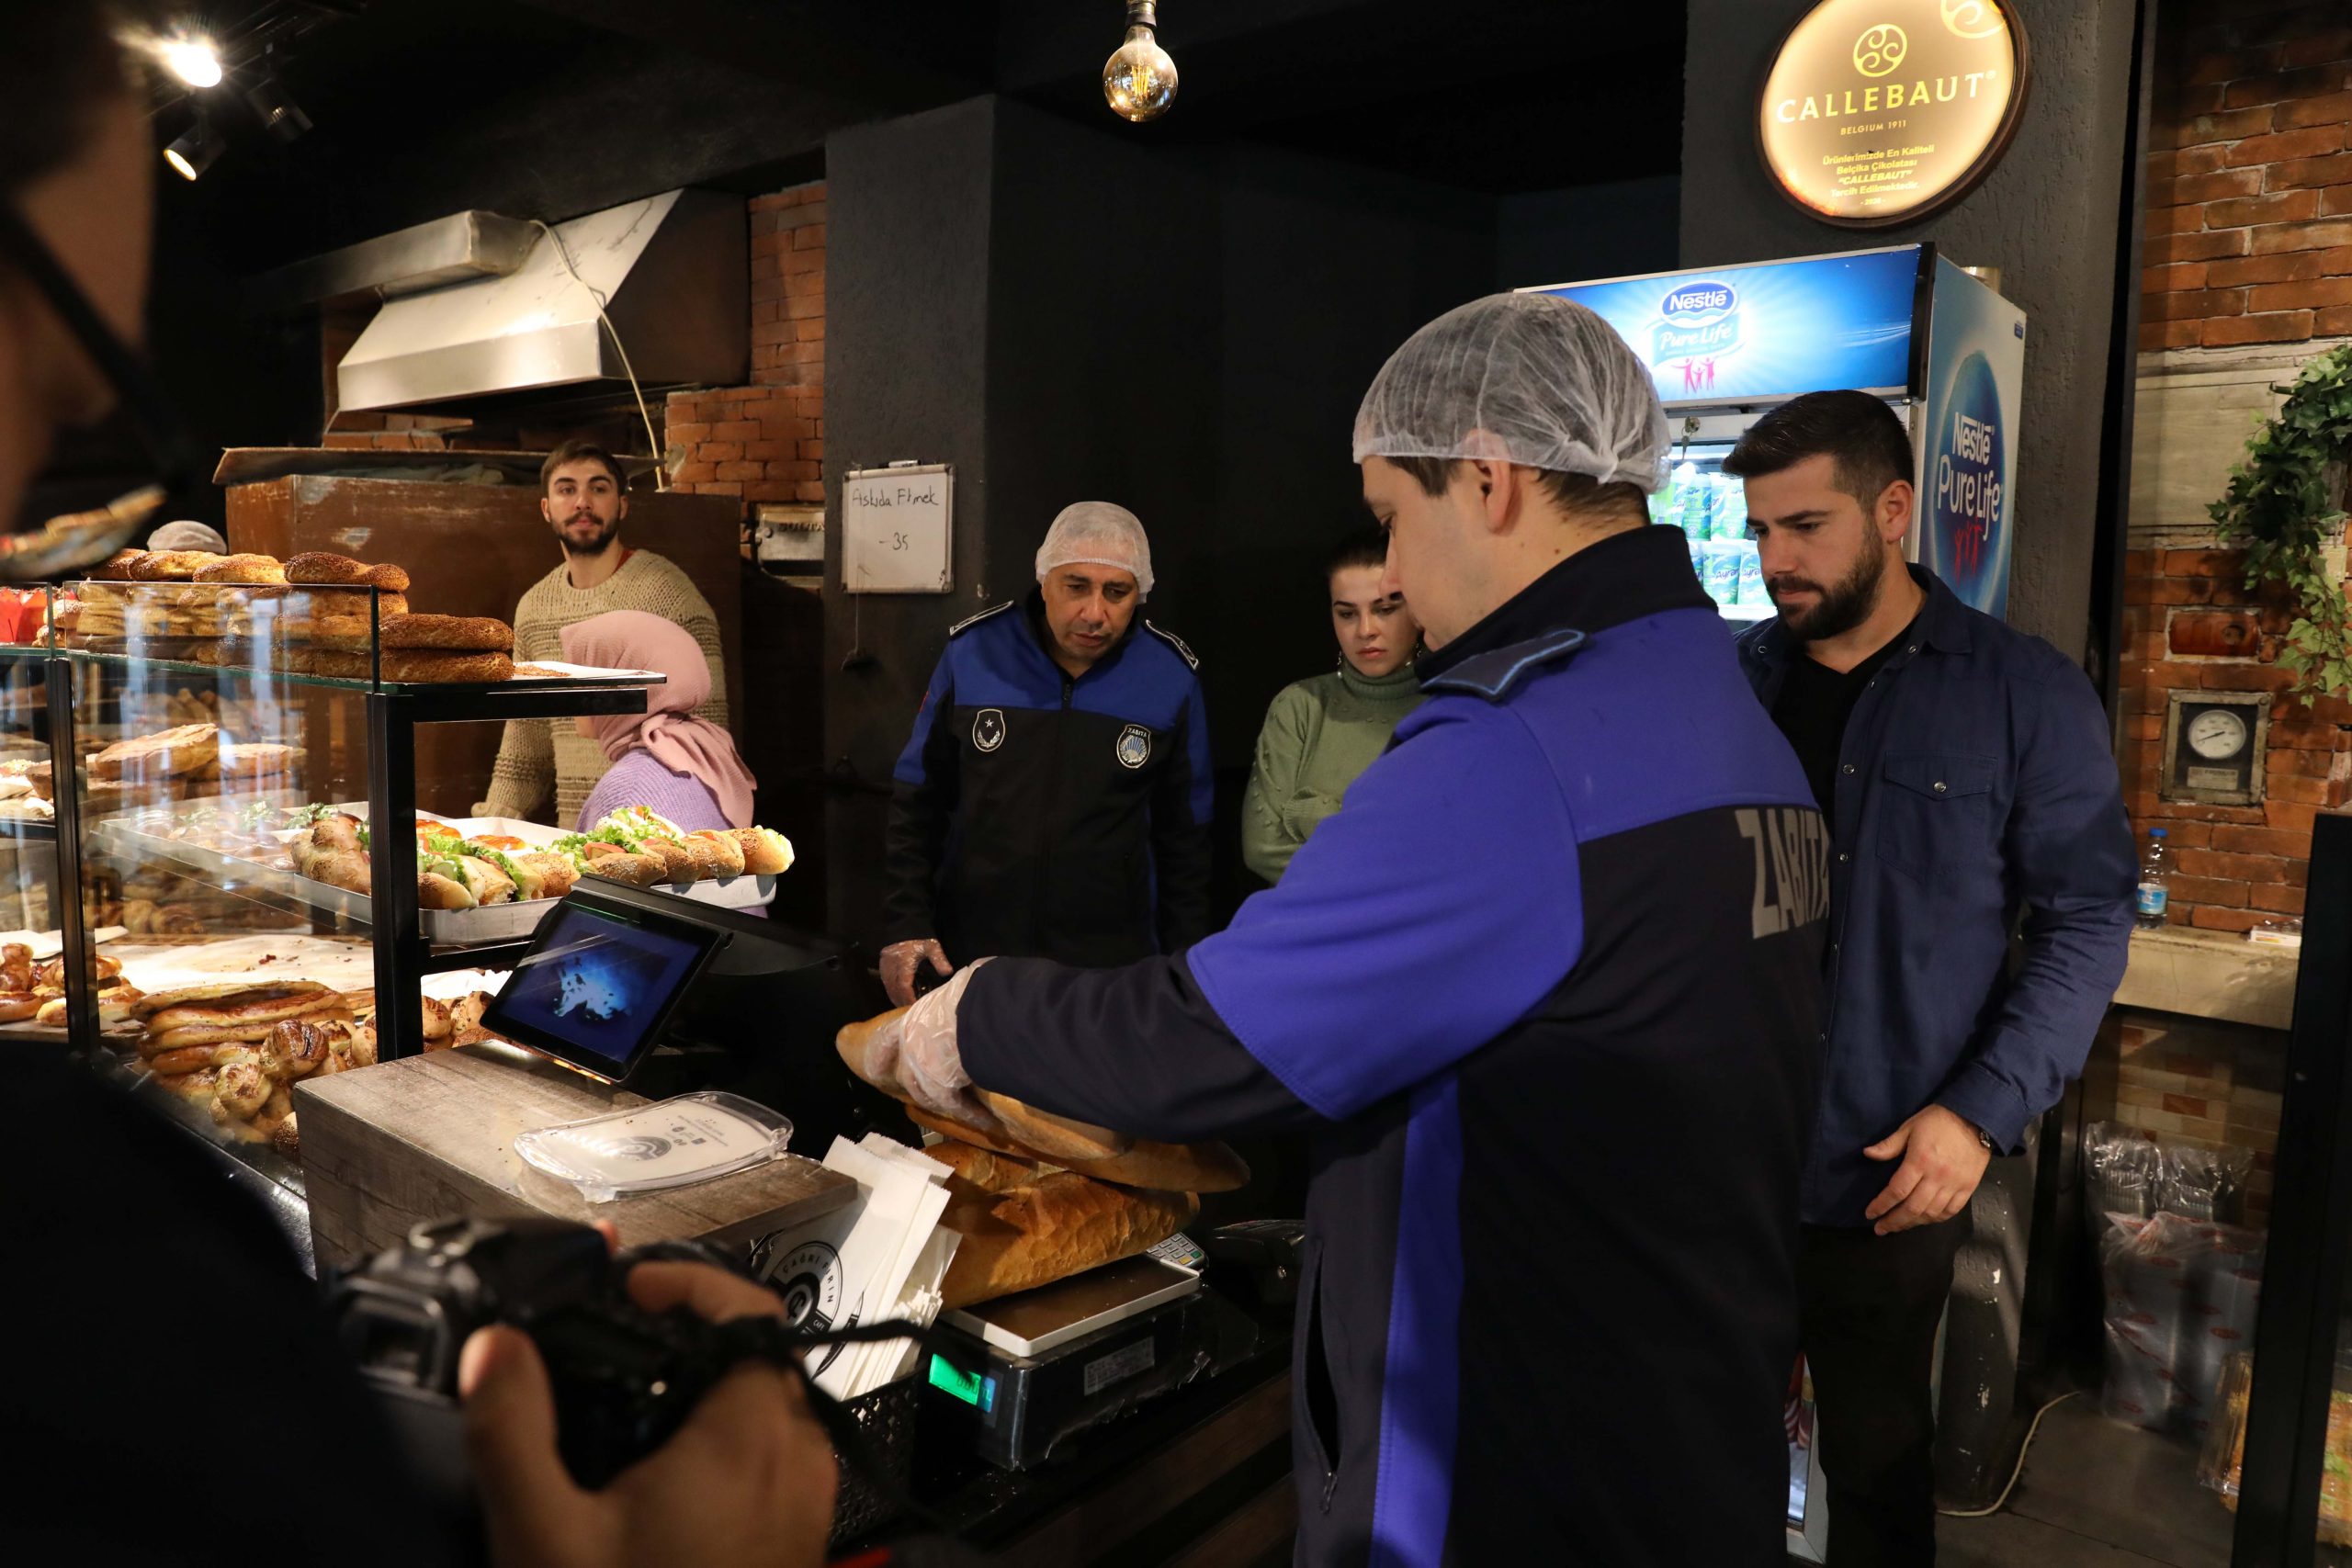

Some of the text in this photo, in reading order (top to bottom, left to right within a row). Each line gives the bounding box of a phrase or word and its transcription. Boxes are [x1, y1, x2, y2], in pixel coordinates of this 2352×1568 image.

[1776, 73, 1986, 123] CALLEBAUT
[1840, 120, 1906, 135] BELGIUM 1911
[1823, 144, 1935, 165] Ürünlerimizde En Kaliteli
[1837, 159, 1918, 175] Belçika Çikolatası
[1660, 332, 1699, 350] Pure
[1700, 323, 1733, 345] Life
[1938, 454, 2000, 542] Pure Life
[1128, 728, 1147, 737] ZABITA
